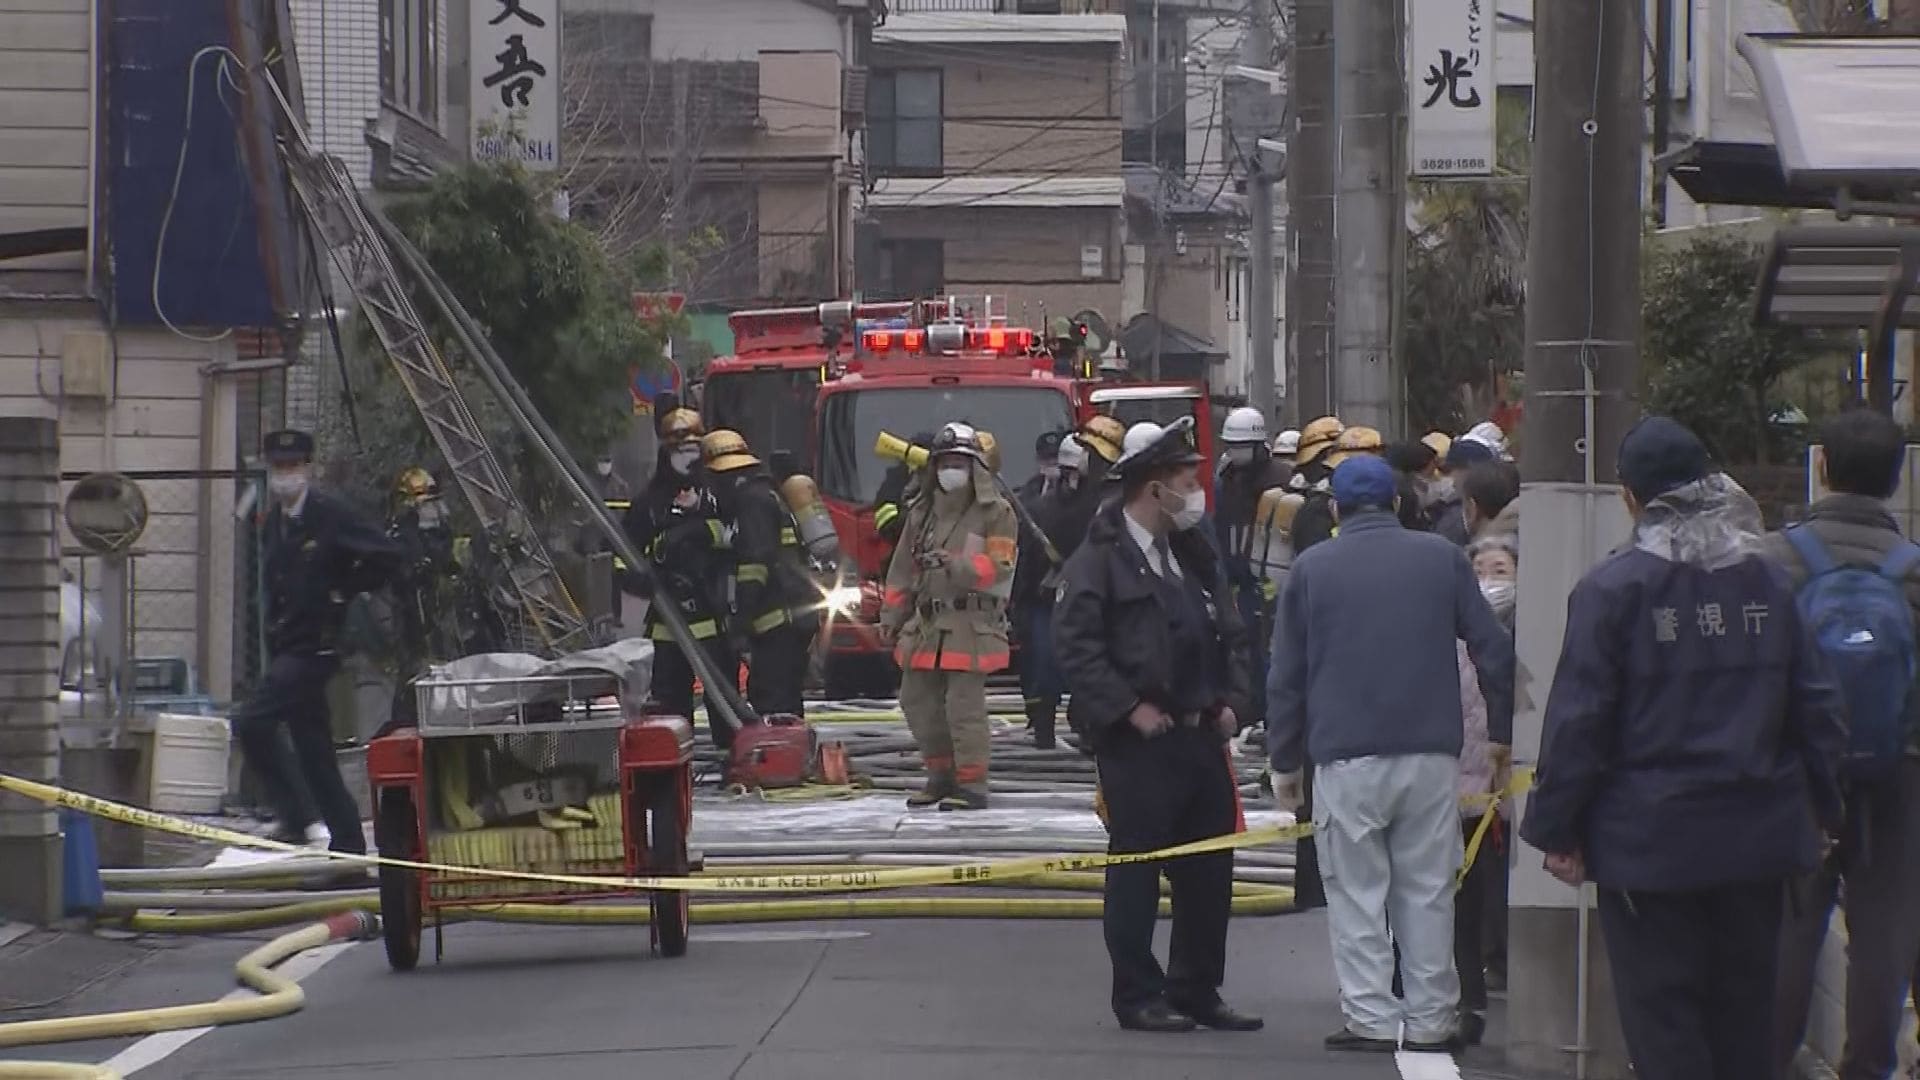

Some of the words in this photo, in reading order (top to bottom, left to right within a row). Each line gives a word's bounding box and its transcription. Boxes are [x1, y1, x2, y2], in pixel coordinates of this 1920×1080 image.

[1421, 48, 1481, 108] 光
[1652, 601, 1768, 641] 警視庁
[778, 876, 832, 888] KEEP
